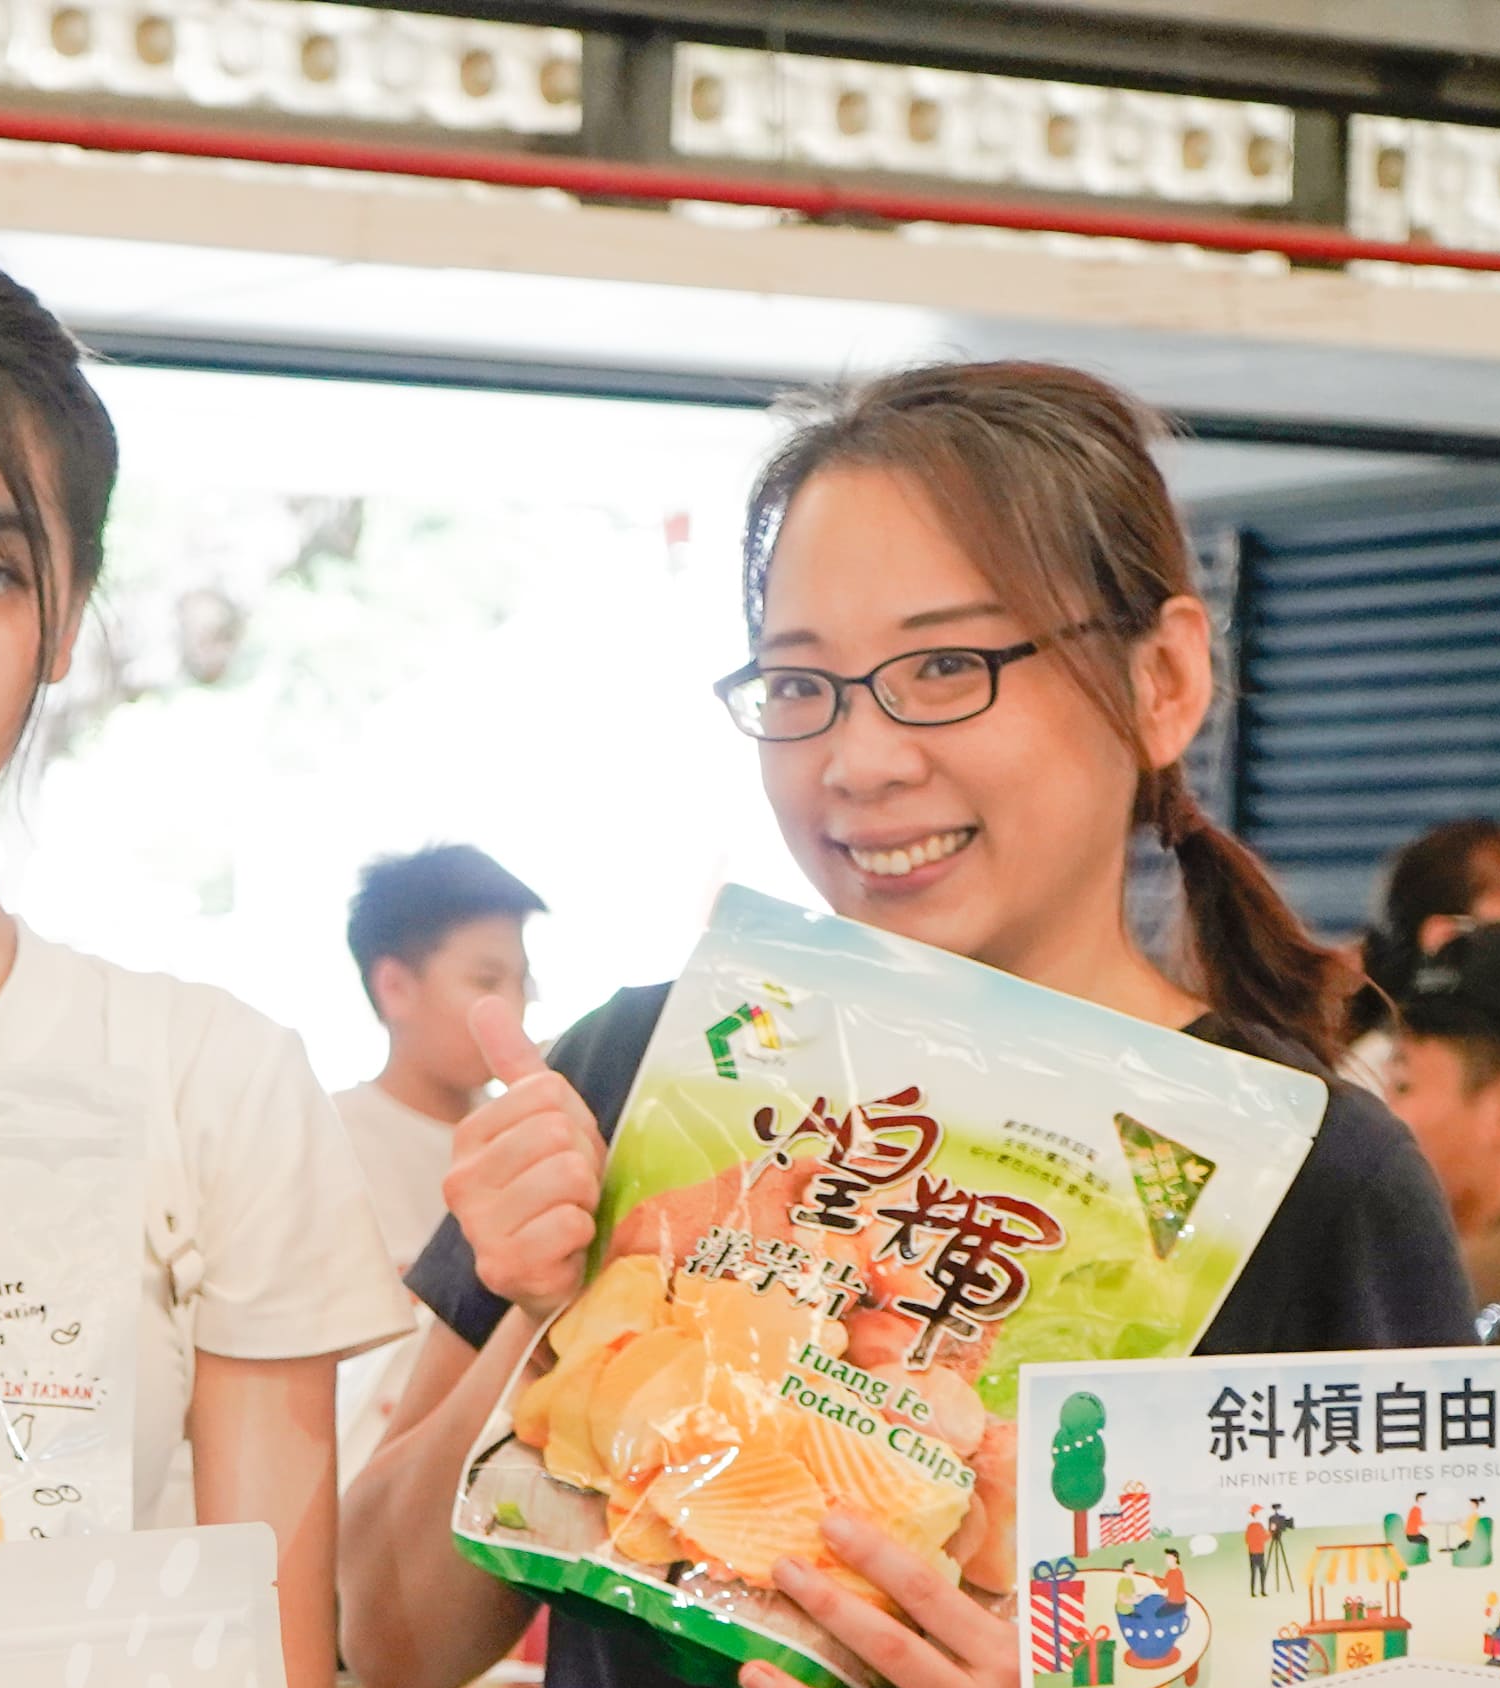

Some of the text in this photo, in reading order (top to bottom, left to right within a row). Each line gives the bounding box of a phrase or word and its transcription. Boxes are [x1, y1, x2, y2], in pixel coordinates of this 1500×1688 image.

[4, 1381, 24, 1397] IN
[31, 1382, 93, 1400] TAIWAN
[798, 1342, 930, 1421] Fuang Fe
[780, 1375, 976, 1491] Potato Chips
[1219, 1468, 1299, 1489] INFINITE
[1305, 1463, 1434, 1485] POSSIBILITIES
[1440, 1461, 1477, 1480] FOR
